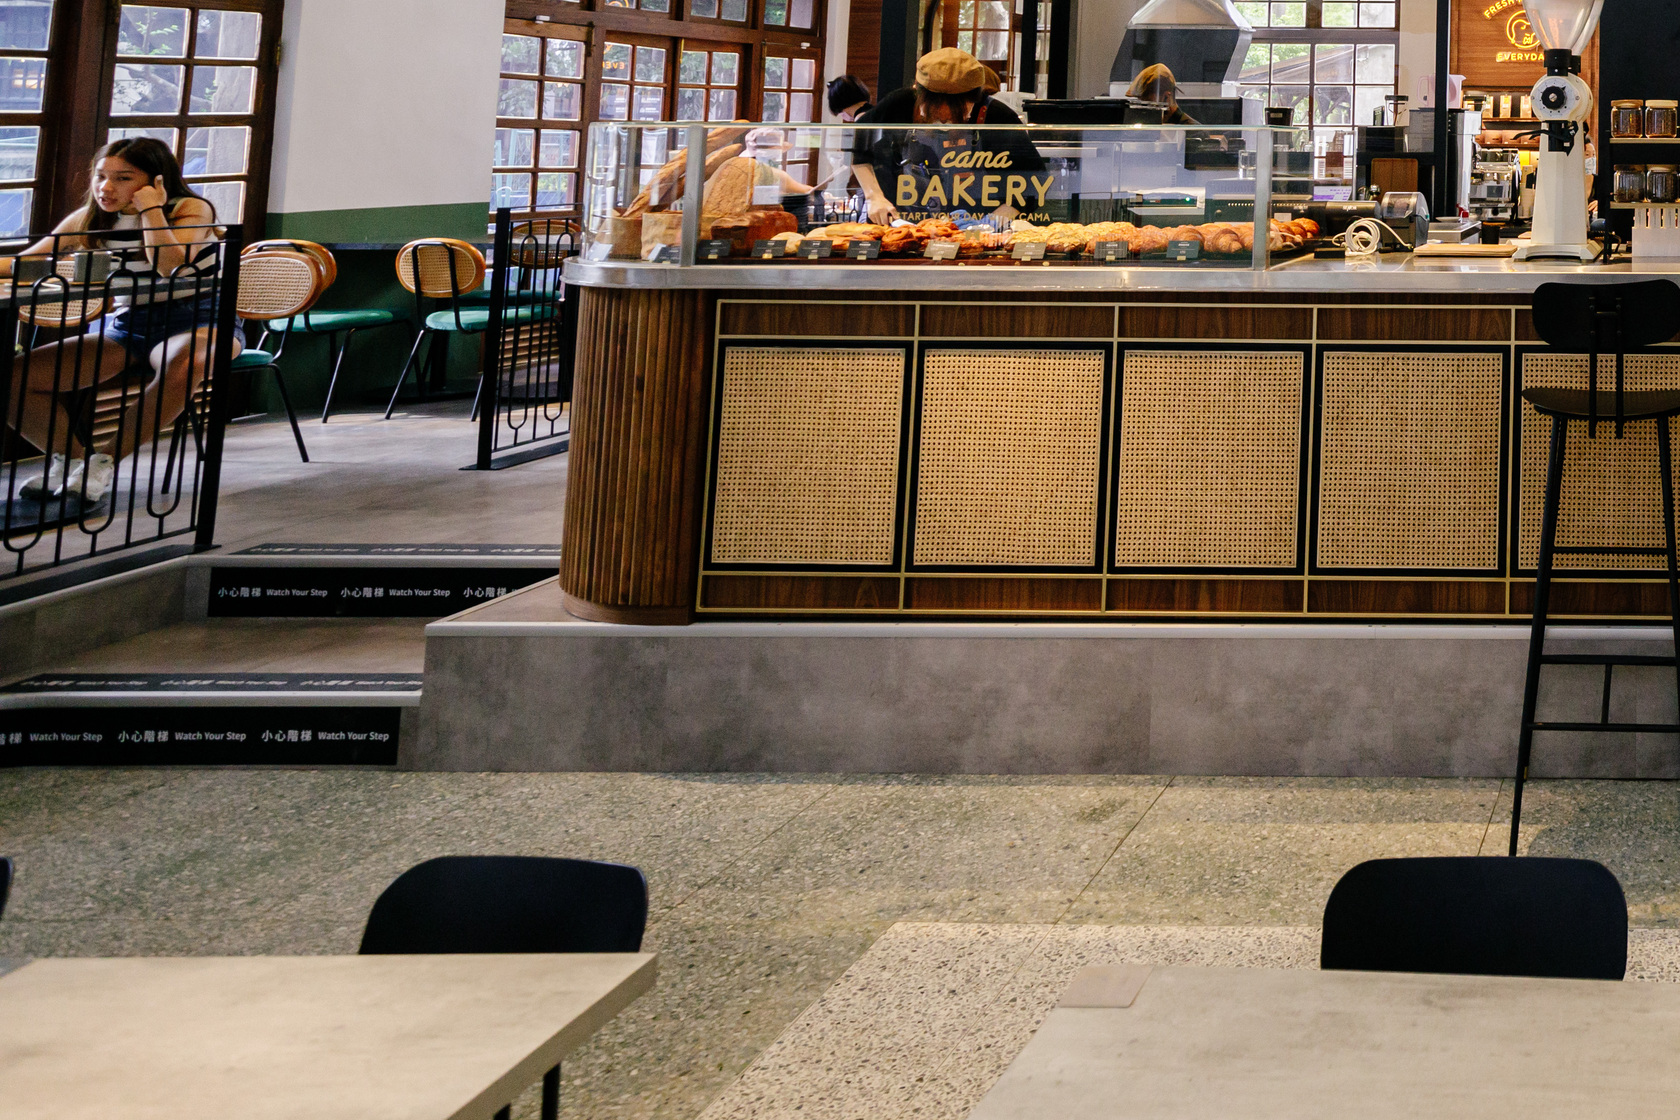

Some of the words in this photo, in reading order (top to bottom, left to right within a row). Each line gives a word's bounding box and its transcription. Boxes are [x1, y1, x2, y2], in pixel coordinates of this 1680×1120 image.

[1496, 52, 1545, 62] EVERYDA
[940, 150, 1013, 169] cama
[895, 174, 1055, 207] BAKERY
[963, 212, 985, 221] DAY
[1019, 212, 1051, 222] CAMA
[218, 587, 262, 598] 小心階梯
[266, 588, 290, 597] Watch
[291, 588, 309, 597] Your
[310, 588, 328, 598] Step
[340, 587, 384, 598] 小心階梯
[388, 588, 413, 597] Watch
[414, 588, 432, 597] Your
[433, 588, 451, 598] Step
[463, 587, 507, 598] 小心階梯
[29, 733, 59, 742] Watch
[60, 733, 81, 742] Your
[82, 732, 103, 743] Step
[118, 730, 169, 743] 小心階梯
[175, 731, 203, 741] Watch
[204, 732, 225, 741] Your
[226, 731, 247, 742] Step
[261, 729, 313, 742] 小心階梯
[318, 731, 346, 741] Watch
[347, 731, 368, 741] Your
[369, 731, 390, 742] Step
